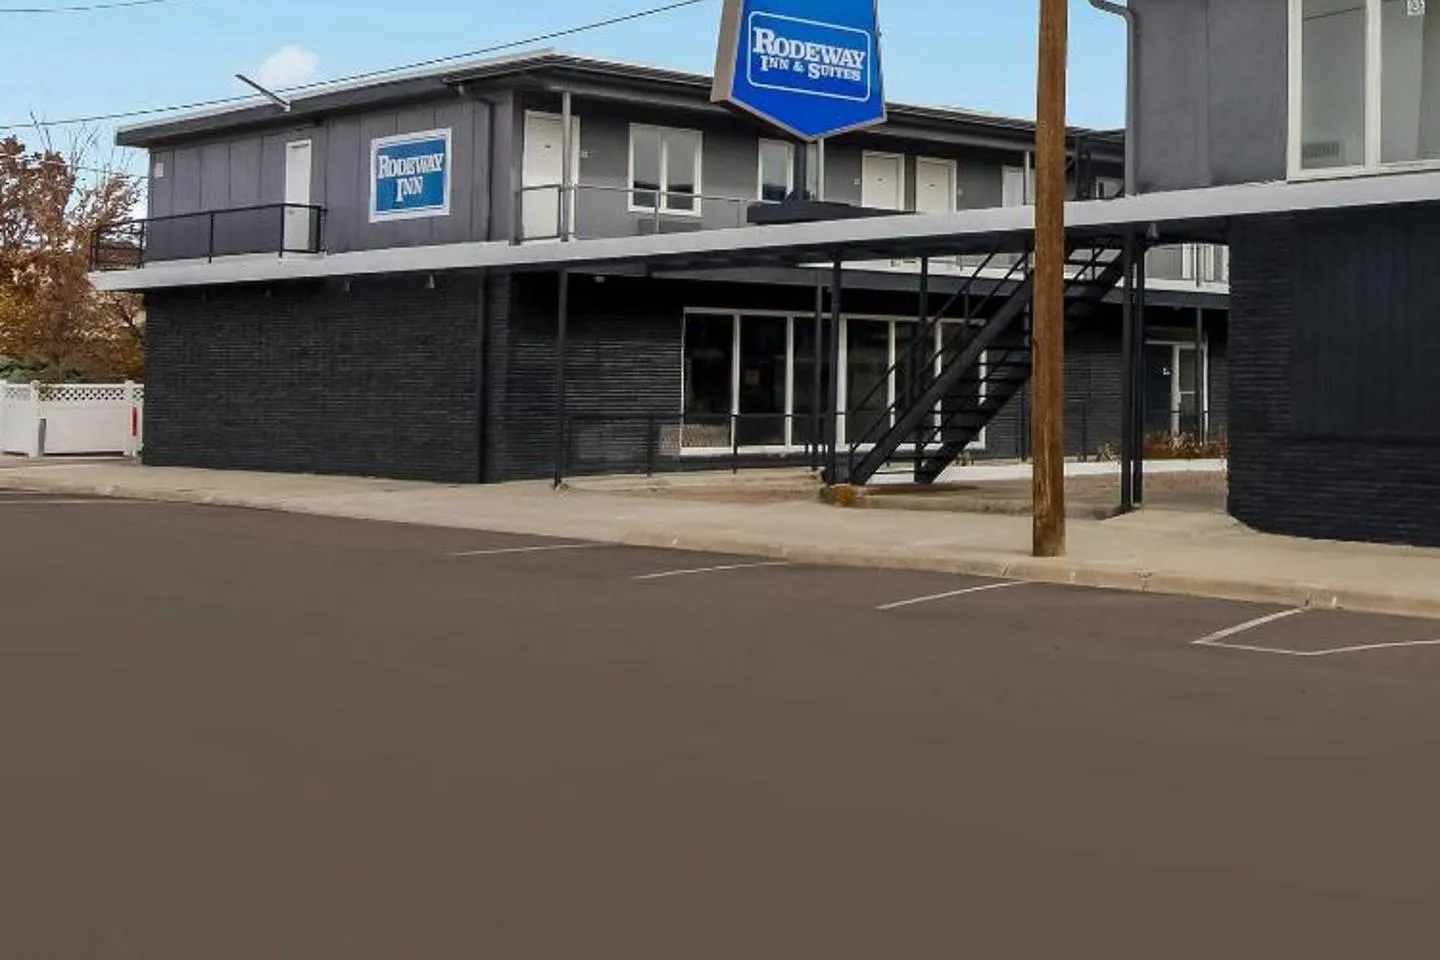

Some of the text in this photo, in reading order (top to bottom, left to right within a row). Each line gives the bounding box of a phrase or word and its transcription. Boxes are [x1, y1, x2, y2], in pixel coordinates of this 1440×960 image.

[752, 27, 866, 69] RODEWAY
[760, 55, 861, 81] INN & SUITES
[378, 153, 444, 179] RODEWAY
[396, 176, 423, 202] INN
